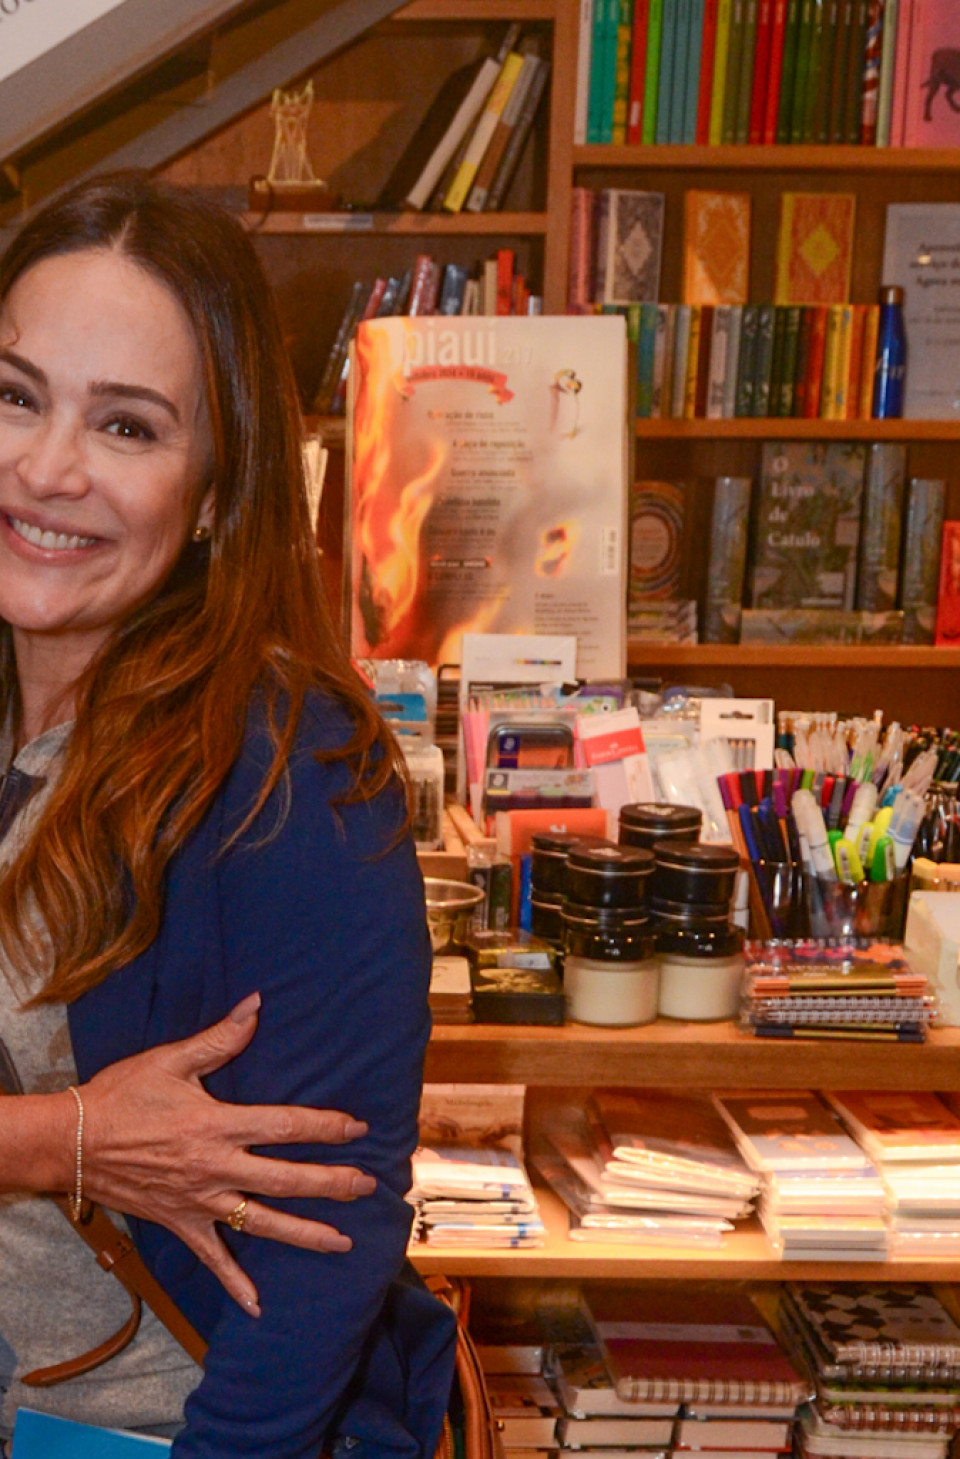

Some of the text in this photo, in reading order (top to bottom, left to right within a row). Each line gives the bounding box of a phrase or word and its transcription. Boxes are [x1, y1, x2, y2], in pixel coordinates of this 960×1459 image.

[404, 317, 498, 377] piauí
[772, 456, 790, 474] O
[771, 481, 816, 499] Livro
[768, 505, 790, 523] de
[767, 530, 822, 548] Catulo
